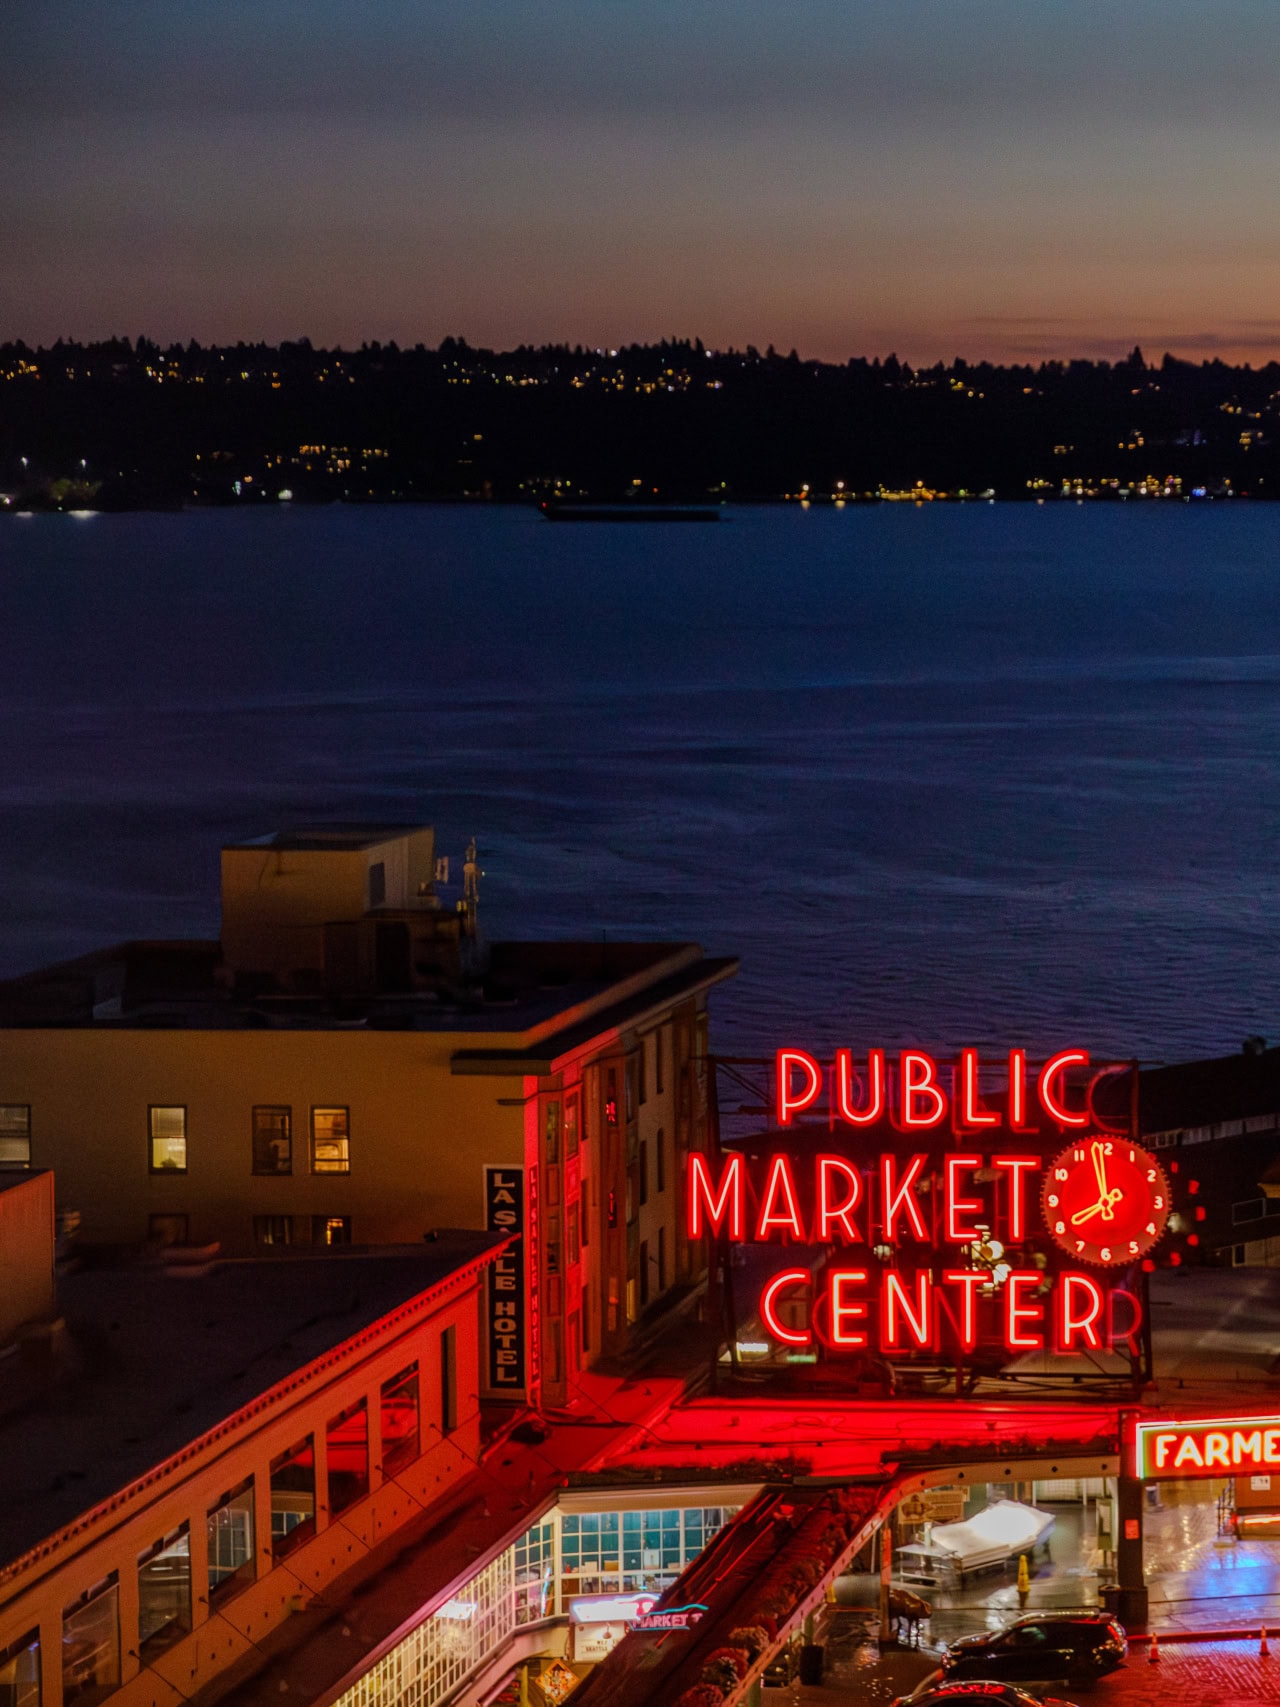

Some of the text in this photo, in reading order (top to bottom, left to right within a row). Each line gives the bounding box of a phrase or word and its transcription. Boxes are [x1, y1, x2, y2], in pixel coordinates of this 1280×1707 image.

[775, 1047, 1090, 1128] PUBLIC
[1055, 1168, 1068, 1181] 10
[1147, 1169, 1156, 1182] 2
[493, 1172, 516, 1204] LA
[688, 1152, 1042, 1242] MARKET
[1048, 1194, 1059, 1207] 9
[1153, 1196, 1163, 1209] 3
[1055, 1221, 1065, 1234] 8
[1146, 1222, 1156, 1235] 4
[493, 1209, 517, 1291] SLE
[1076, 1240, 1085, 1252] 7
[1129, 1241, 1139, 1254] 5
[1100, 1247, 1111, 1261] 6
[761, 1268, 1106, 1350] CENTER
[494, 1301, 518, 1383] HOTEL
